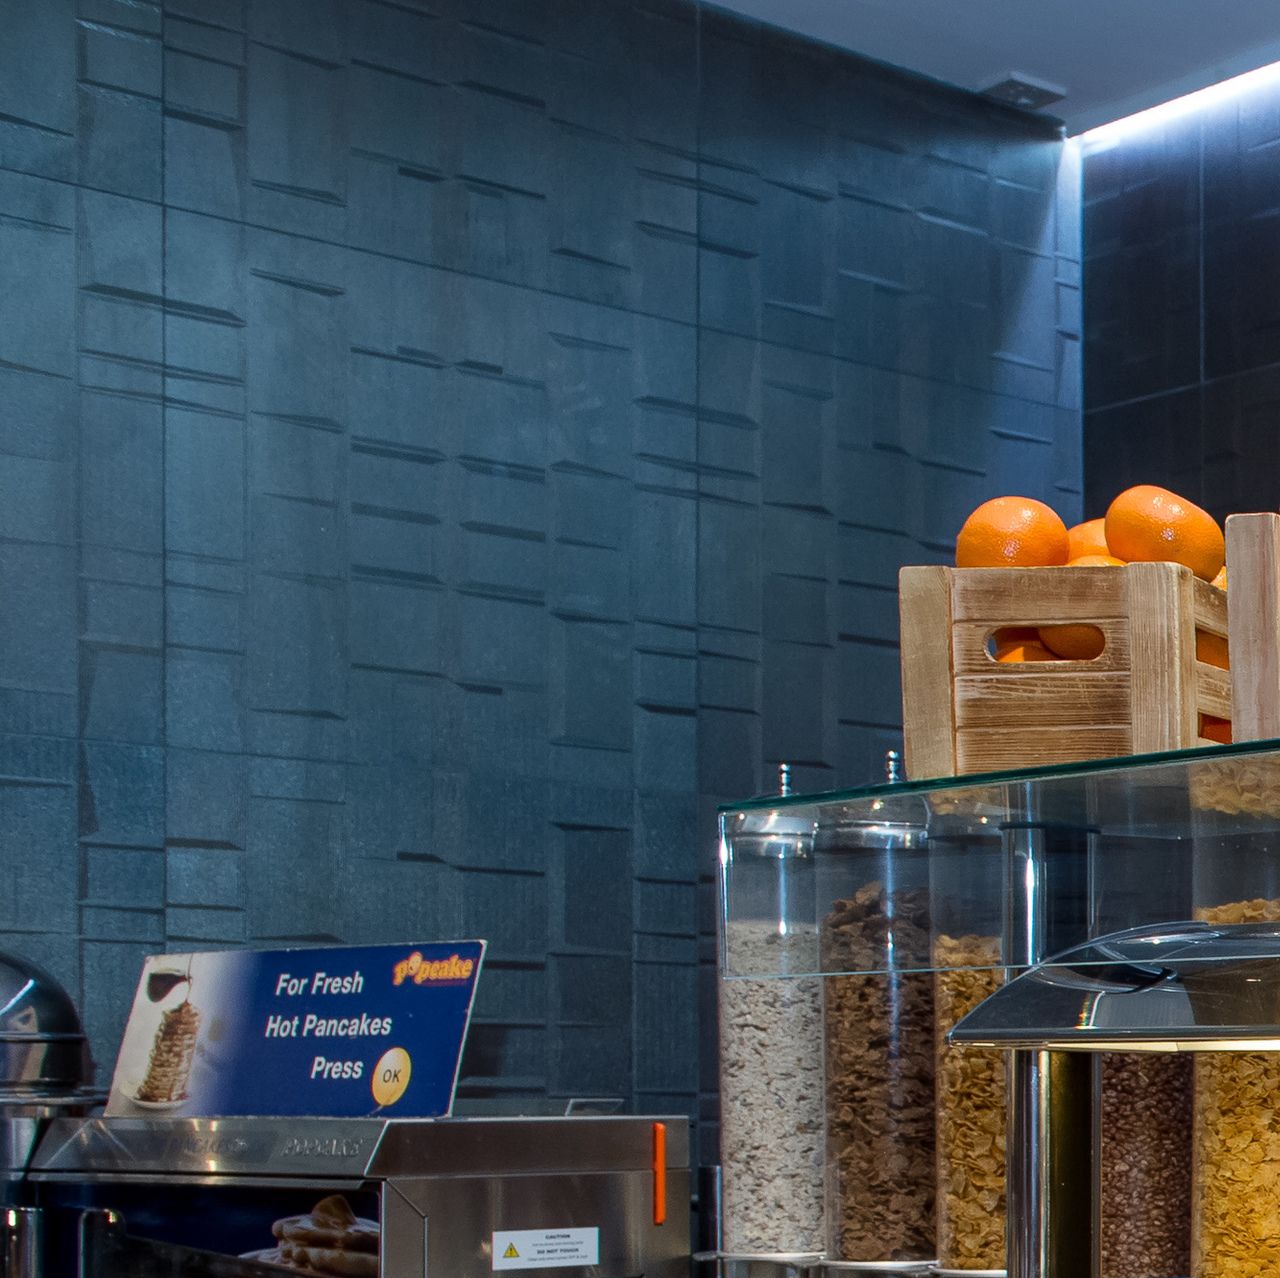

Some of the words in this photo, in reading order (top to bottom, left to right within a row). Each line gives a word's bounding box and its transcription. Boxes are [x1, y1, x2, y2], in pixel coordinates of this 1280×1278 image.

[275, 973, 308, 996] For
[311, 971, 364, 995] Fresh
[265, 1014, 299, 1038] Hot
[302, 1012, 393, 1038] Pancakes
[310, 1056, 364, 1080] Press
[383, 1068, 402, 1083] OK
